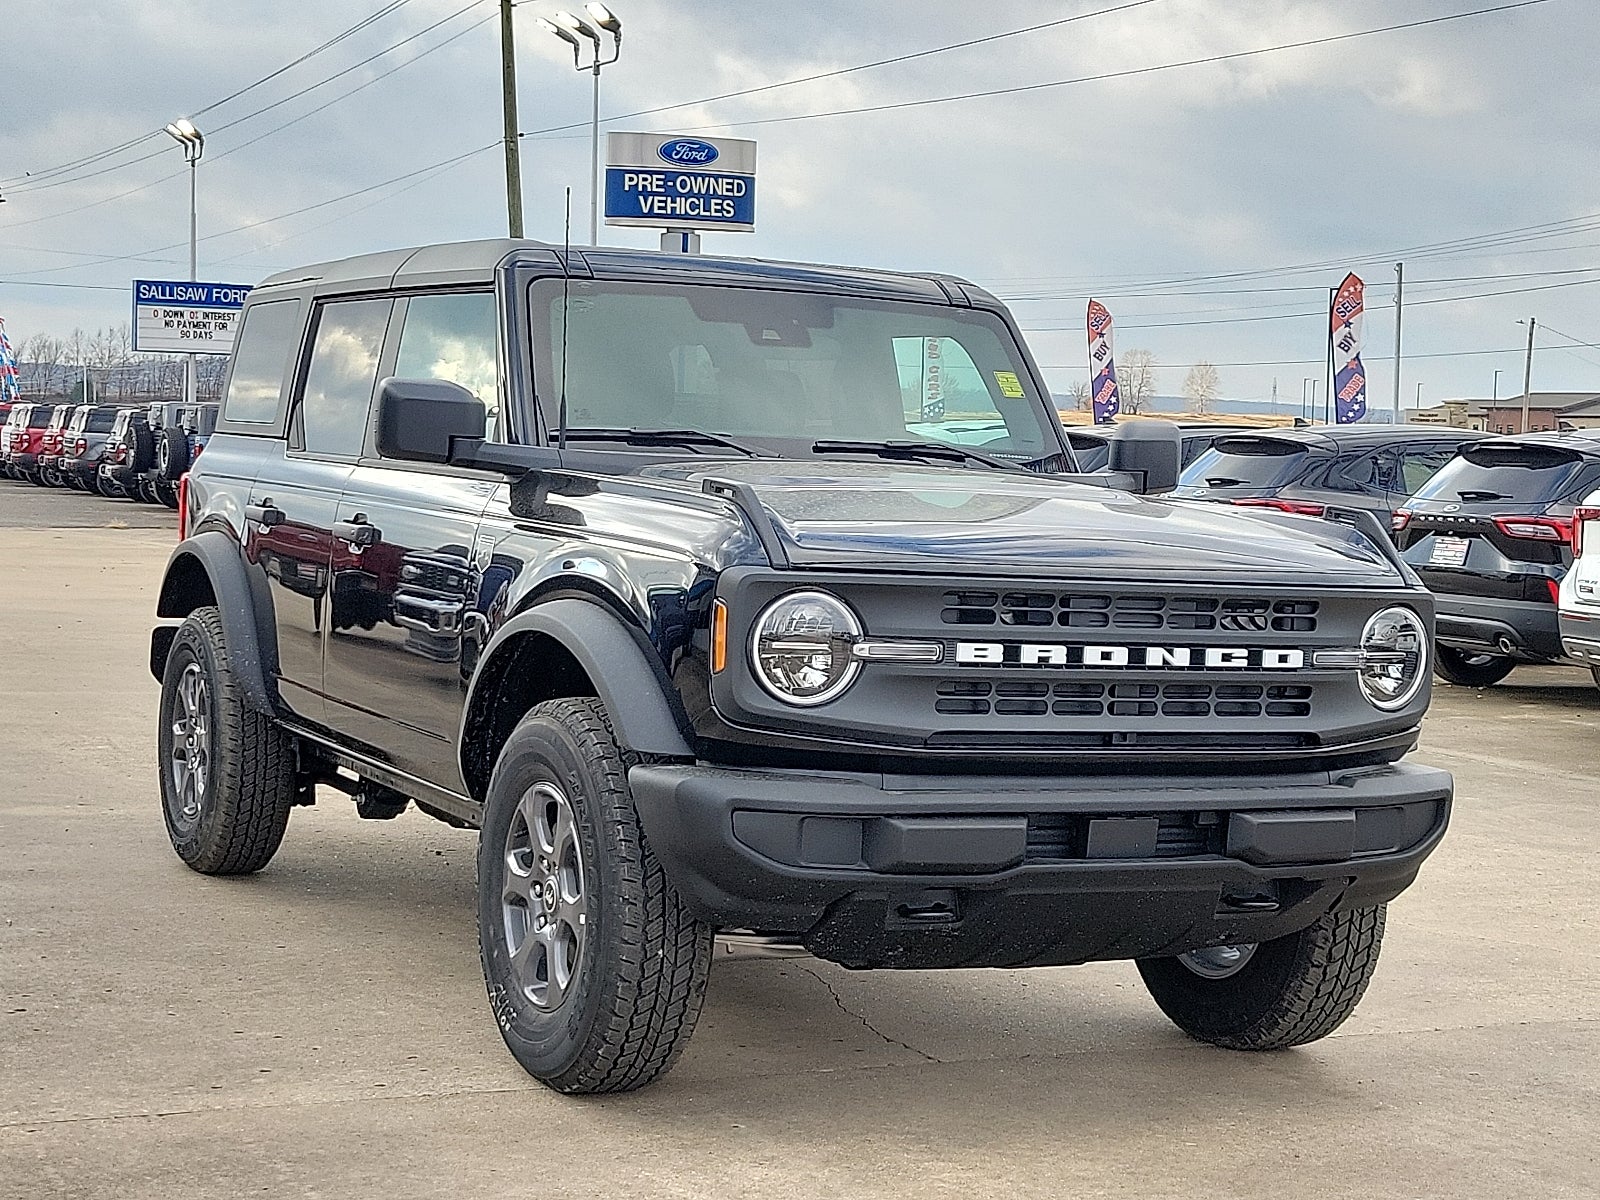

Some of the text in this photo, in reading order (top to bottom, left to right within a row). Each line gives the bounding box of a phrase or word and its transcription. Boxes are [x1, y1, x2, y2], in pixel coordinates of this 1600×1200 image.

[671, 142, 709, 161] Ford
[624, 173, 746, 197] PRE-OWNED
[638, 195, 735, 218] VEHICLES
[139, 284, 249, 303] SALLISAW FORD
[163, 309, 185, 319] DOWN
[202, 311, 237, 322] INTEREST
[1335, 296, 1361, 318] SELL
[164, 319, 228, 331] NO PAYMENT FOR
[180, 330, 214, 340] 90 DAYS
[1093, 341, 1111, 362] BUY
[955, 642, 1305, 669] BRONCO
